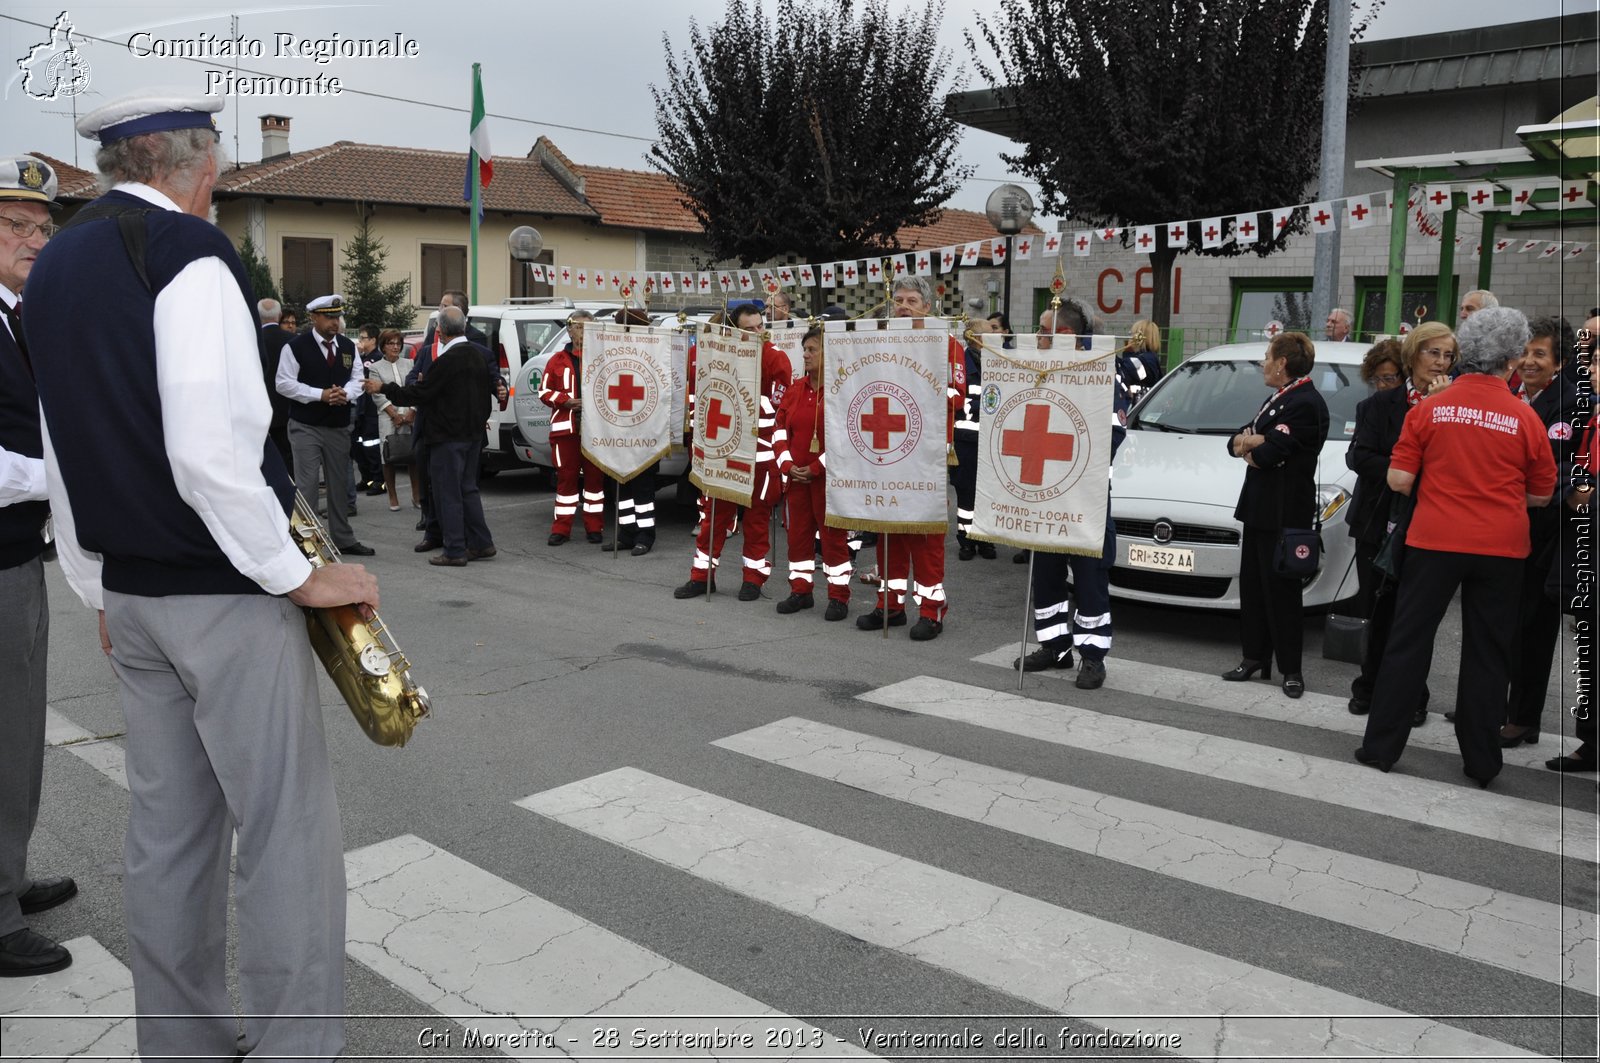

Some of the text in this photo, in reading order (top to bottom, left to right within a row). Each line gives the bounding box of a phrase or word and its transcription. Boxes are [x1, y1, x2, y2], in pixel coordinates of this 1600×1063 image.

[828, 335, 943, 346] CORPO VOLONTARI DEL SOCCORSO
[585, 353, 606, 384] CROCE
[605, 346, 638, 359] ROSSA
[640, 350, 670, 392] ITALIANA
[986, 358, 1108, 372] CORPO VOLONTARI DEL SOCCORSO
[830, 361, 861, 395] CROCE
[860, 352, 898, 367] ROSSA
[900, 355, 943, 397] ITALIANA
[982, 371, 1113, 386] CROCE ROSSA ITALIANA
[595, 361, 657, 424] CONVENZIONE DI GINEVRA 22 AGOSTO 1864
[867, 384, 900, 396] GINEVRA
[899, 392, 911, 403] 22
[907, 402, 920, 438] AGOSTO
[994, 389, 1042, 429] CONVENZIONE
[1046, 391, 1057, 400] DI
[1057, 398, 1087, 435] GINEVRA
[1432, 406, 1519, 429] CROCE ROSSA ITALIANA
[848, 396, 866, 453] CONVENZIONE
[1432, 416, 1518, 435] COMITATO FEMMINILE
[591, 437, 658, 448] SAVIGLIANO
[900, 438, 915, 454] 1864
[704, 468, 713, 478] DI
[830, 479, 937, 491] COMITATO LOCALE DI
[864, 494, 898, 507] BRA
[991, 502, 1030, 517] COMITATO
[1039, 510, 1084, 523] LOCALE
[995, 515, 1069, 537] MORETTA
[1178, 554, 1192, 567] AA
